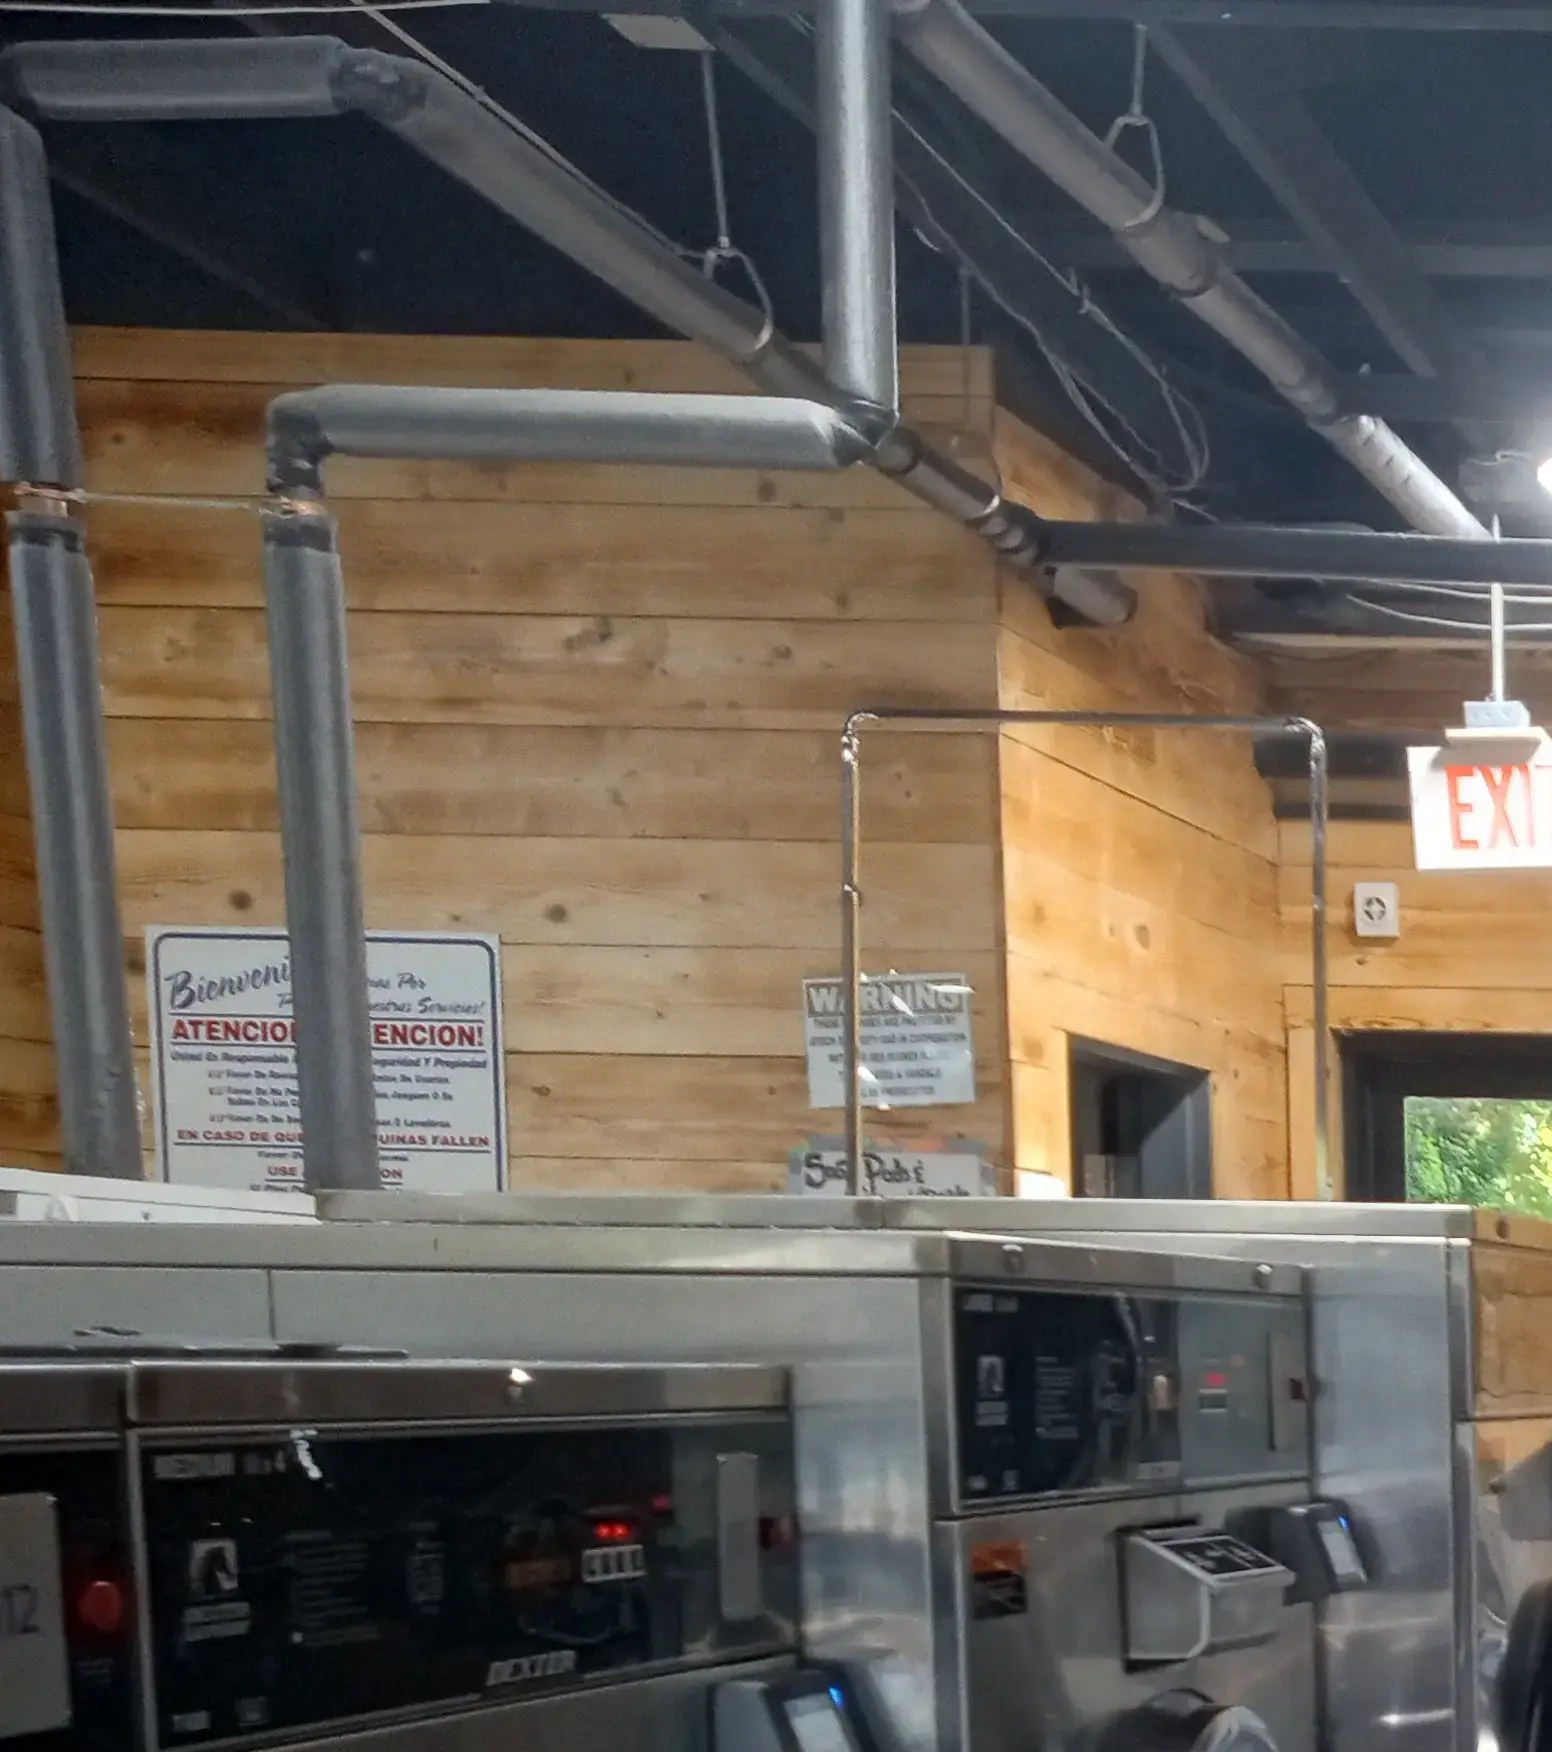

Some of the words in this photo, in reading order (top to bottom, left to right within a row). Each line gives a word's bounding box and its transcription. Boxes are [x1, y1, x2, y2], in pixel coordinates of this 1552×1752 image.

[163, 956, 289, 1010] Bienveni
[808, 982, 962, 1013] WRNING
[373, 1023, 484, 1047] ENCION!
